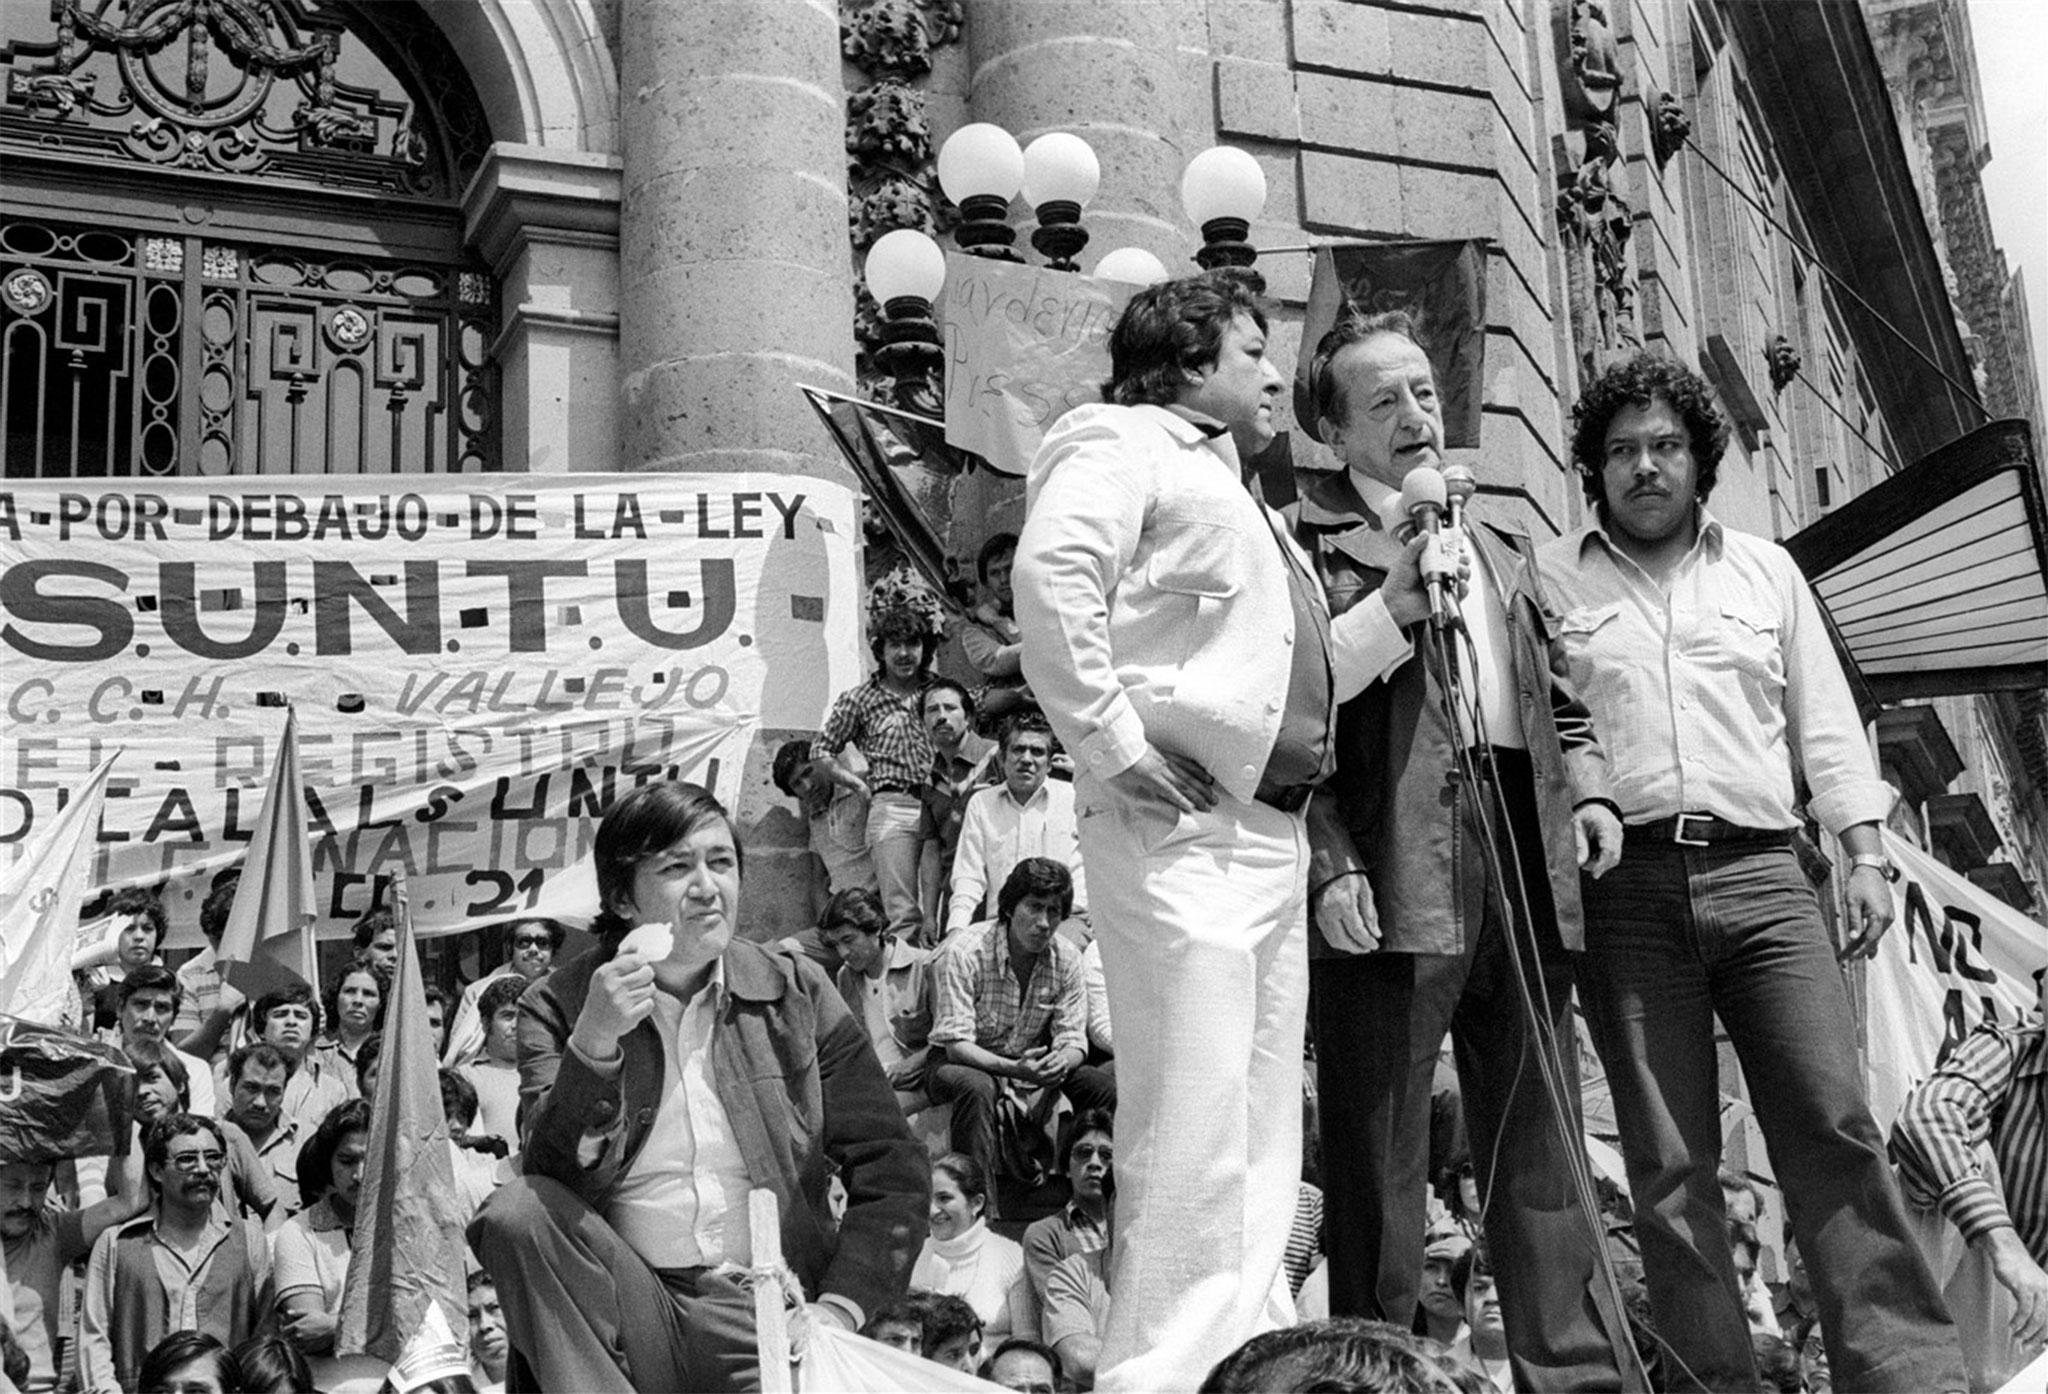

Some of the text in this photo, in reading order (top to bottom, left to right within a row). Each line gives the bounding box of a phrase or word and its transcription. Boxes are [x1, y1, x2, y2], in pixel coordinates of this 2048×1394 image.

[59, 493, 169, 541] POR
[208, 493, 428, 541] DEBAJO
[469, 494, 537, 540] DE
[573, 493, 648, 540] LA
[697, 492, 807, 540] LEY
[7, 665, 730, 724] C.C.H. VALLEJO
[465, 867, 546, 917] 21
